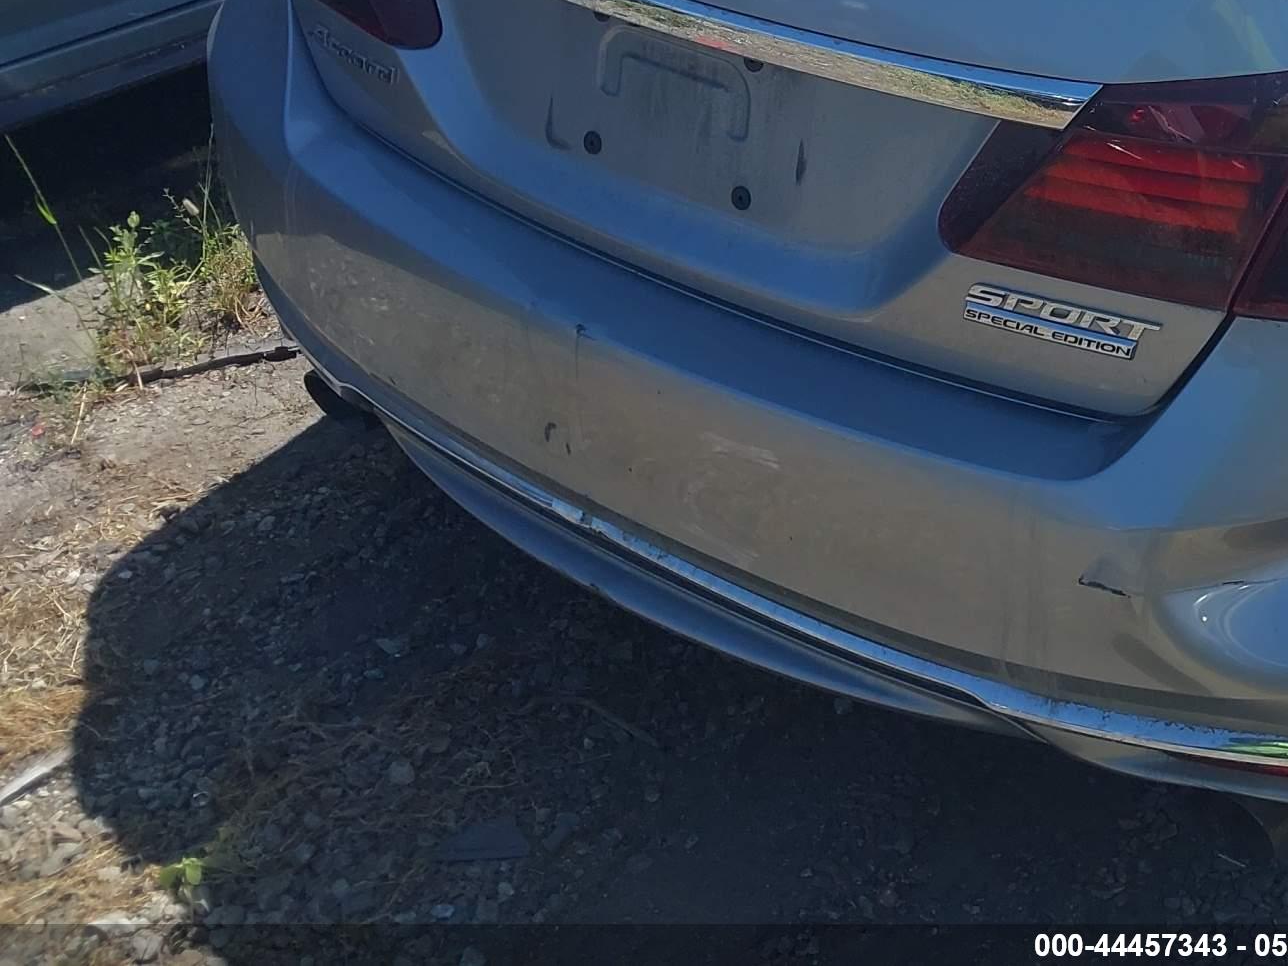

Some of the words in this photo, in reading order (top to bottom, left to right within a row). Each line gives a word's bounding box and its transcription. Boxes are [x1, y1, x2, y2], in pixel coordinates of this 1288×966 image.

[965, 284, 1162, 340] SPORT
[965, 308, 1045, 337] SPECIAL
[1051, 330, 1131, 357] EDITION
